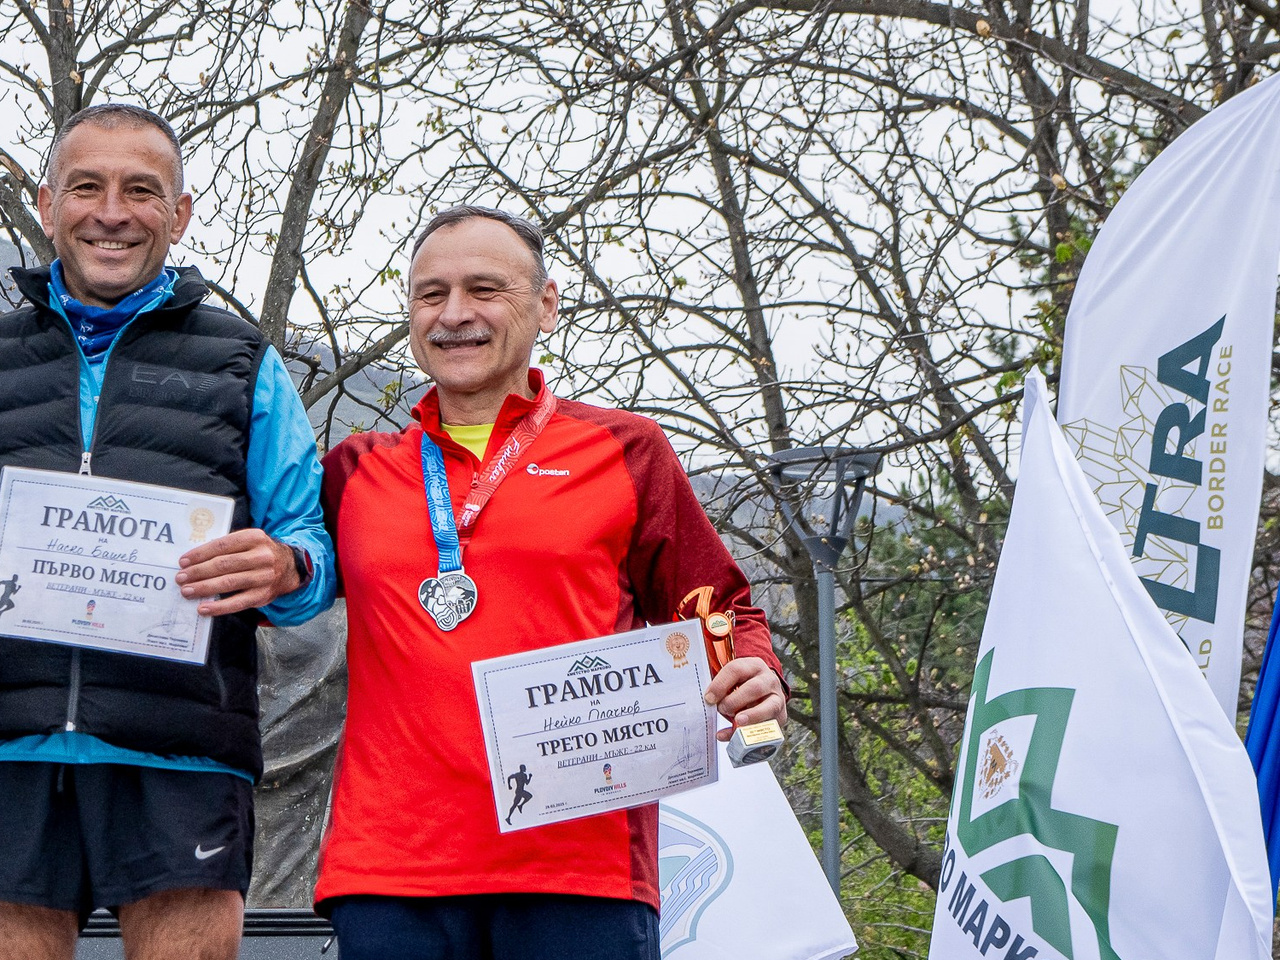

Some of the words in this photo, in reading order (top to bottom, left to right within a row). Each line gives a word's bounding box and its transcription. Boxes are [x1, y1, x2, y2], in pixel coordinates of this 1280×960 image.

[1213, 345, 1234, 411] RACE
[1133, 313, 1226, 640] LTRA
[1207, 421, 1229, 530] BORDER
[41, 505, 175, 544] ГРАМОТА
[32, 559, 96, 582] ПЪРВО
[101, 568, 167, 591] МЯСТО
[46, 582, 88, 595] ВЕТЕРАНИ
[525, 663, 663, 709] ГРАМОТА
[537, 732, 598, 757] ТРЕТО
[603, 718, 669, 746] МЯСТО
[557, 754, 598, 769] ВЕТЕРАНИ
[604, 747, 629, 760] МЪЖЕ
[634, 745, 642, 753] 22
[644, 743, 657, 751] КМ
